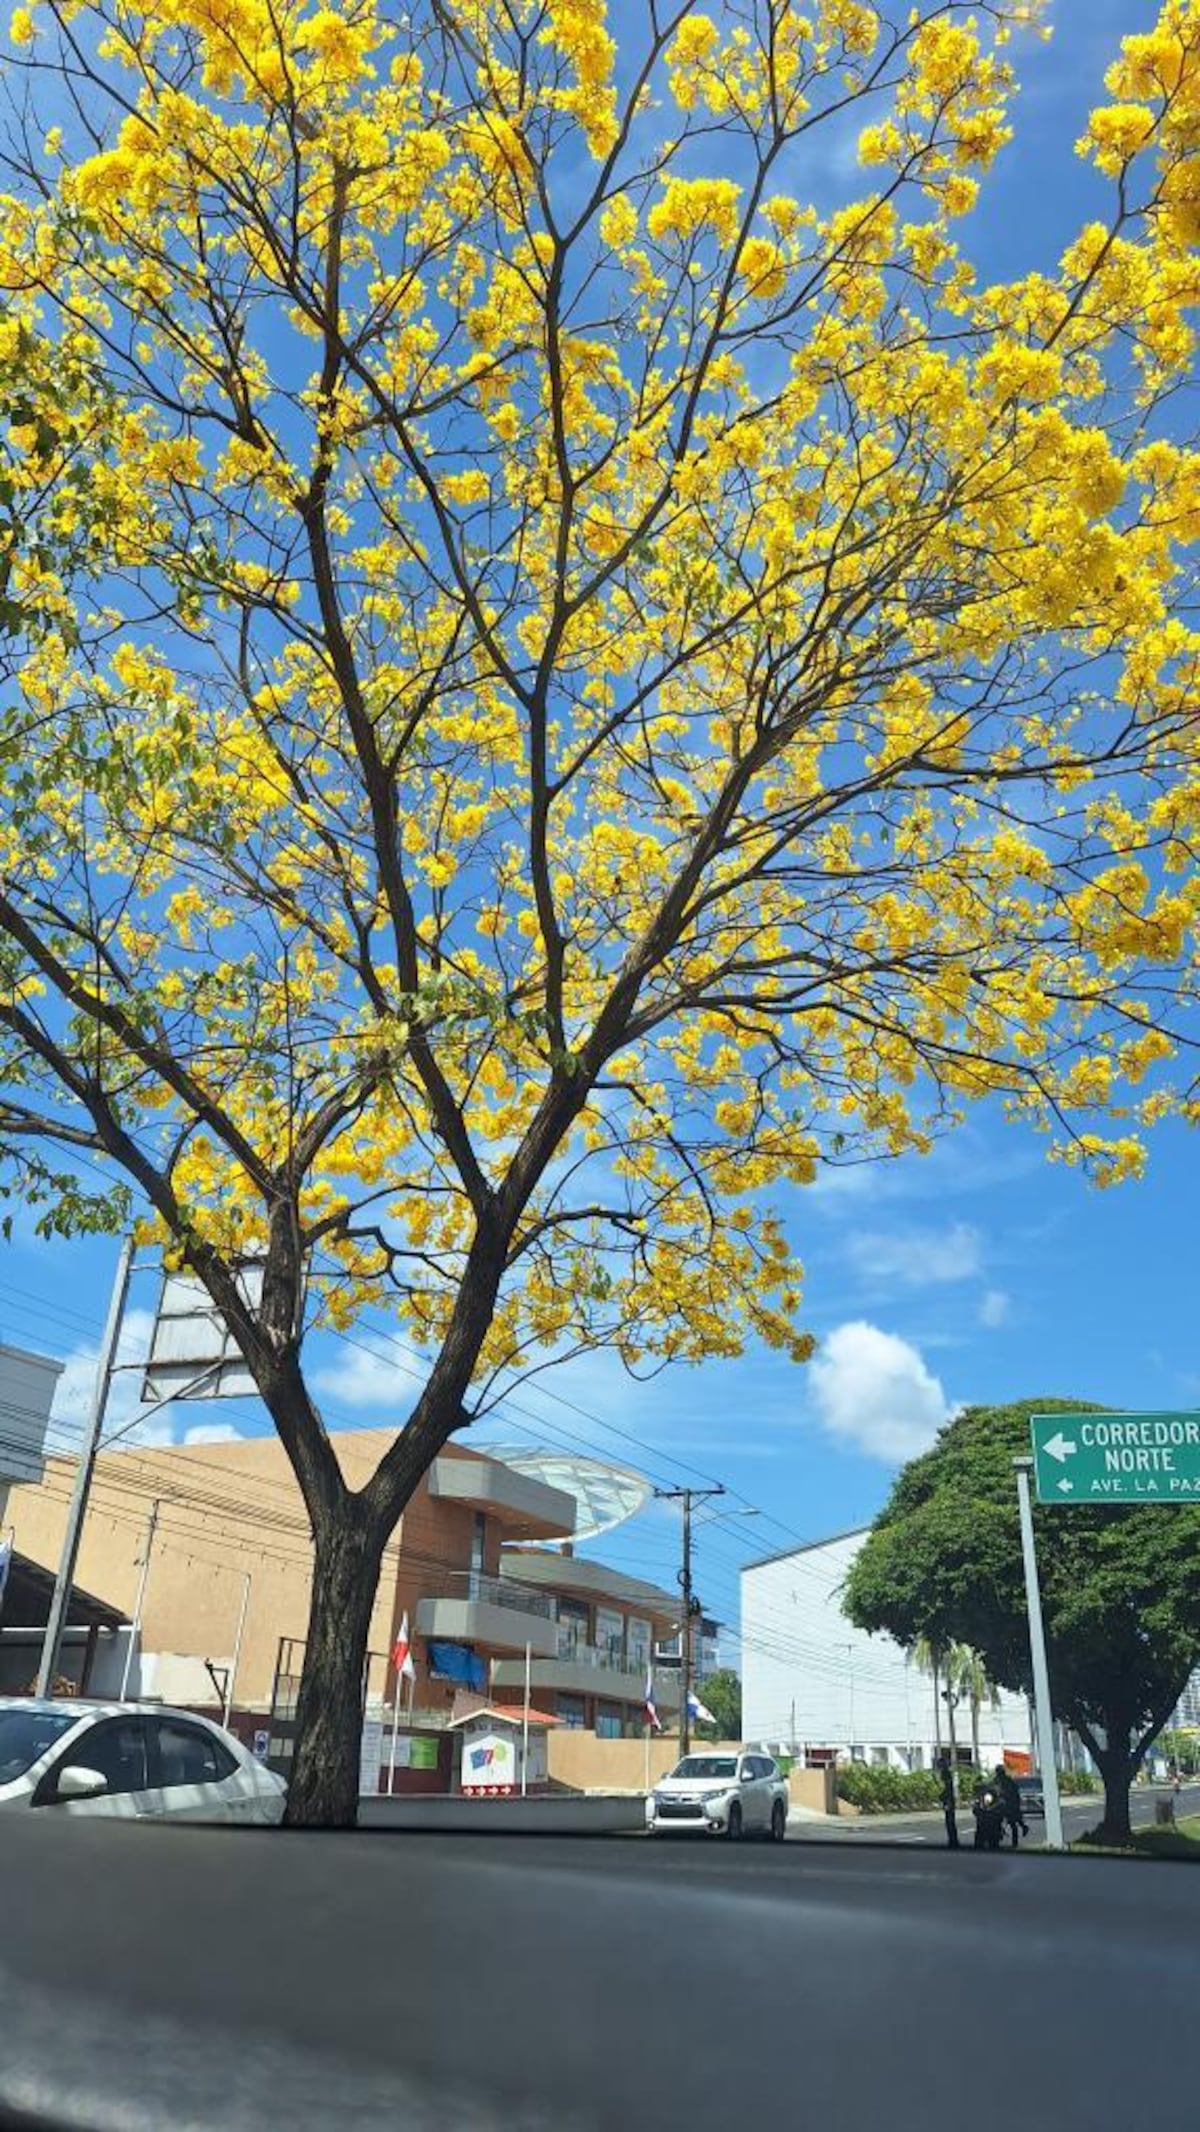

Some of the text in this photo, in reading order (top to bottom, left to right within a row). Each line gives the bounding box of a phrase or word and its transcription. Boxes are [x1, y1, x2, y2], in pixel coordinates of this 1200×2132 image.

[1081, 1421, 1200, 1446] CORREDOR
[1105, 1448, 1176, 1472] NORTE
[1091, 1478, 1200, 1492] AVE. LA PAZ
